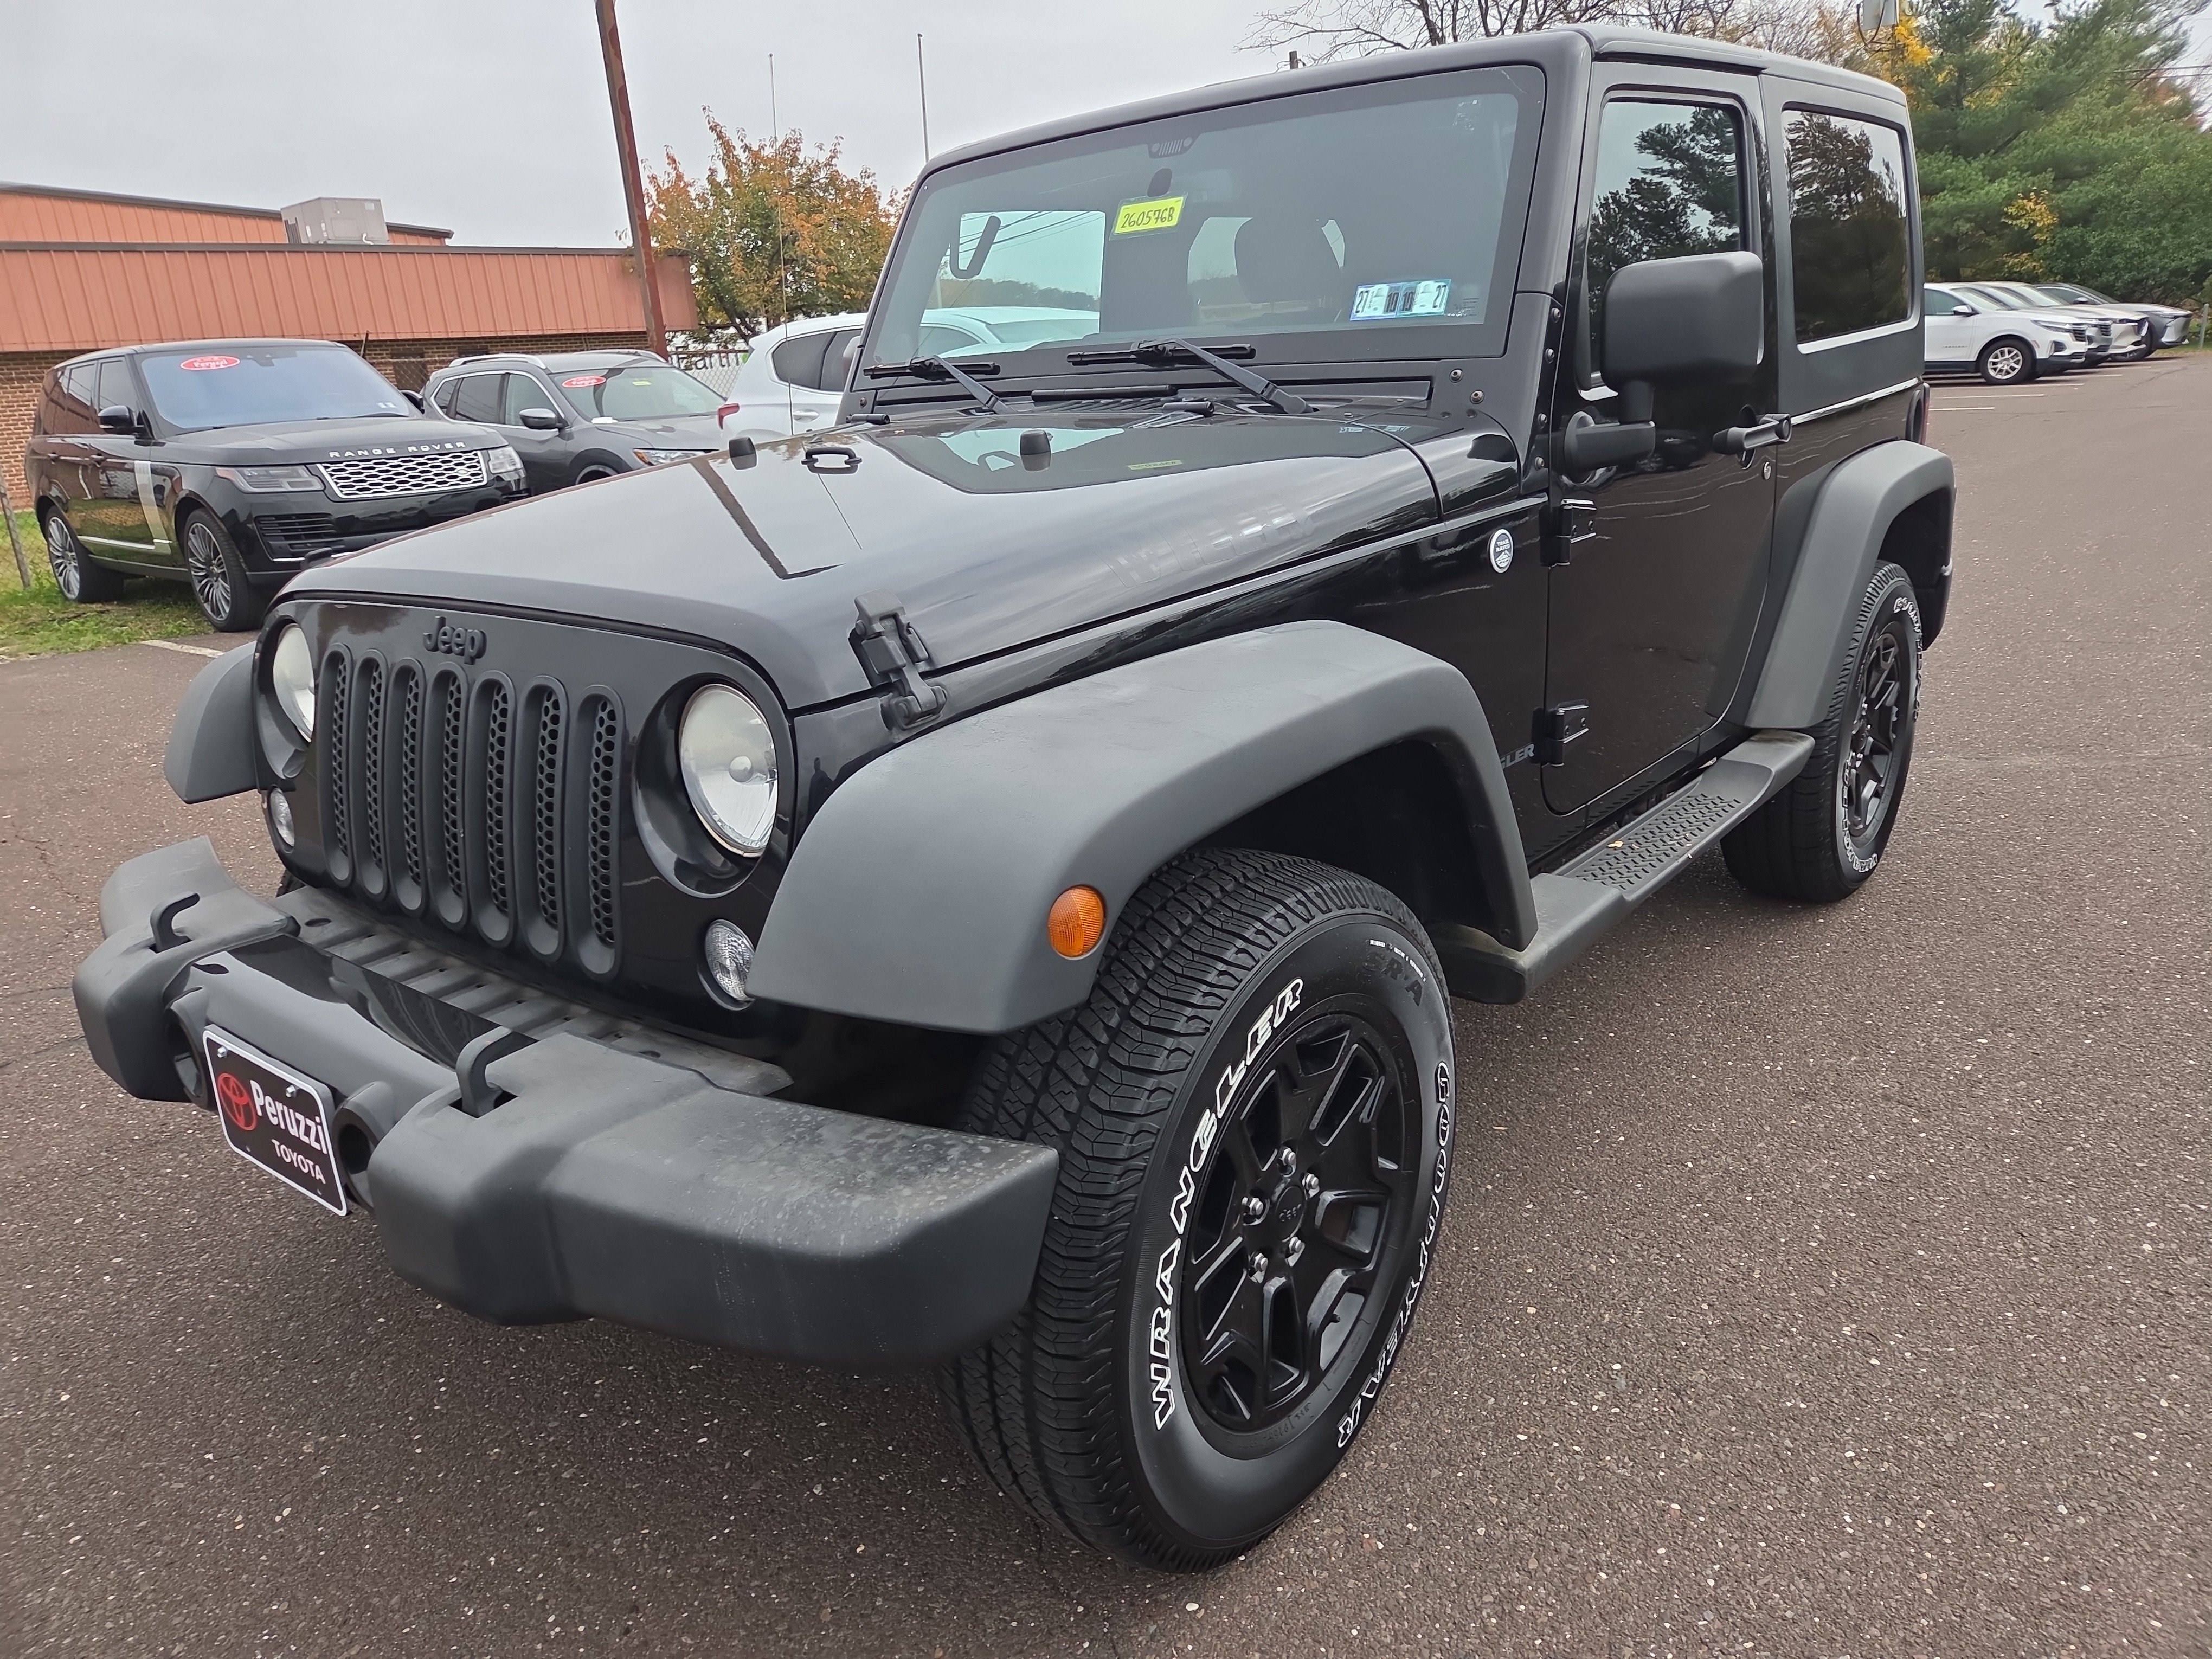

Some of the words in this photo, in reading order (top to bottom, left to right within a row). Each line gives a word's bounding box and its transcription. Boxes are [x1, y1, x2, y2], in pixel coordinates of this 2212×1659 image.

[1355, 290, 1370, 313] 27
[1432, 284, 1448, 308] 27
[329, 448, 396, 458] RANGE
[407, 441, 466, 453] ROVER
[423, 616, 487, 665] Jeep
[250, 1079, 327, 1154] Peruzzi
[272, 1139, 326, 1185] TOYOTA
[1150, 979, 1303, 1431] WRANGLER
[1337, 1062, 1451, 1448] GOODYEAR
